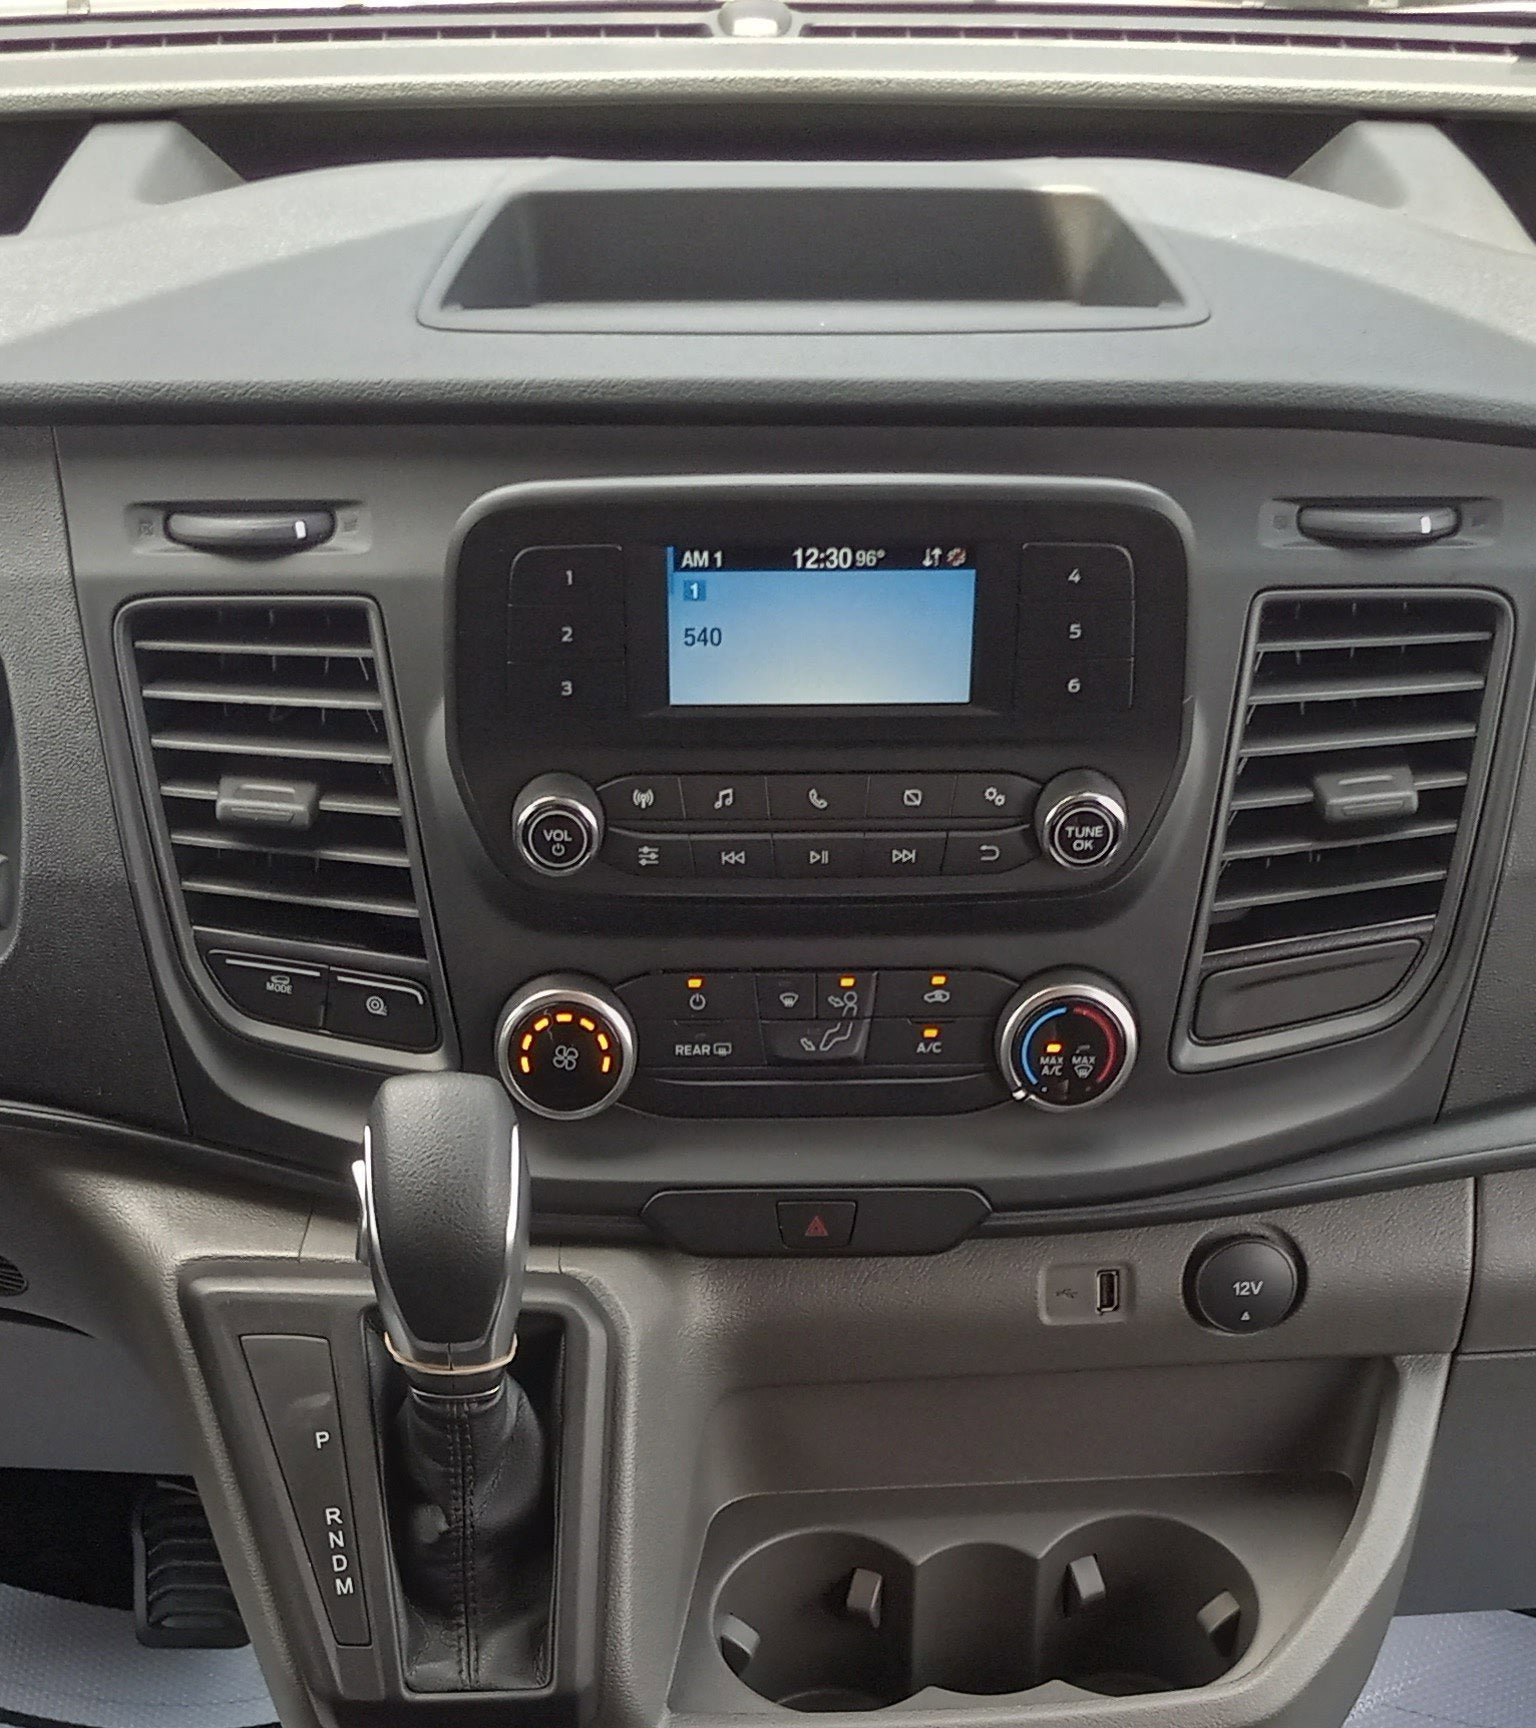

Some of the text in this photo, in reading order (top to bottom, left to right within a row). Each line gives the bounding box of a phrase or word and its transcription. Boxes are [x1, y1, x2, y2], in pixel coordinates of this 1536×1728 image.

[681, 550, 723, 568] AM 1
[792, 547, 852, 569] 12:30
[565, 569, 573, 586] 1
[1067, 569, 1082, 584] 4
[690, 582, 699, 600] 1
[561, 627, 573, 643] 2
[683, 627, 722, 647] 540
[1068, 624, 1082, 639] 5
[561, 681, 573, 697] 3
[1067, 679, 1081, 694] 6
[543, 829, 573, 842] VOL
[1065, 825, 1104, 839] TUNE
[1072, 839, 1094, 852] OK
[266, 983, 293, 995] MODE
[675, 1044, 711, 1056] REAR
[916, 1043, 943, 1054] A/C
[1039, 1055, 1064, 1066] MAX
[1071, 1054, 1097, 1065] MAX
[1041, 1065, 1064, 1076] A/C
[1232, 1281, 1263, 1297] 12V
[315, 1431, 330, 1449] P
